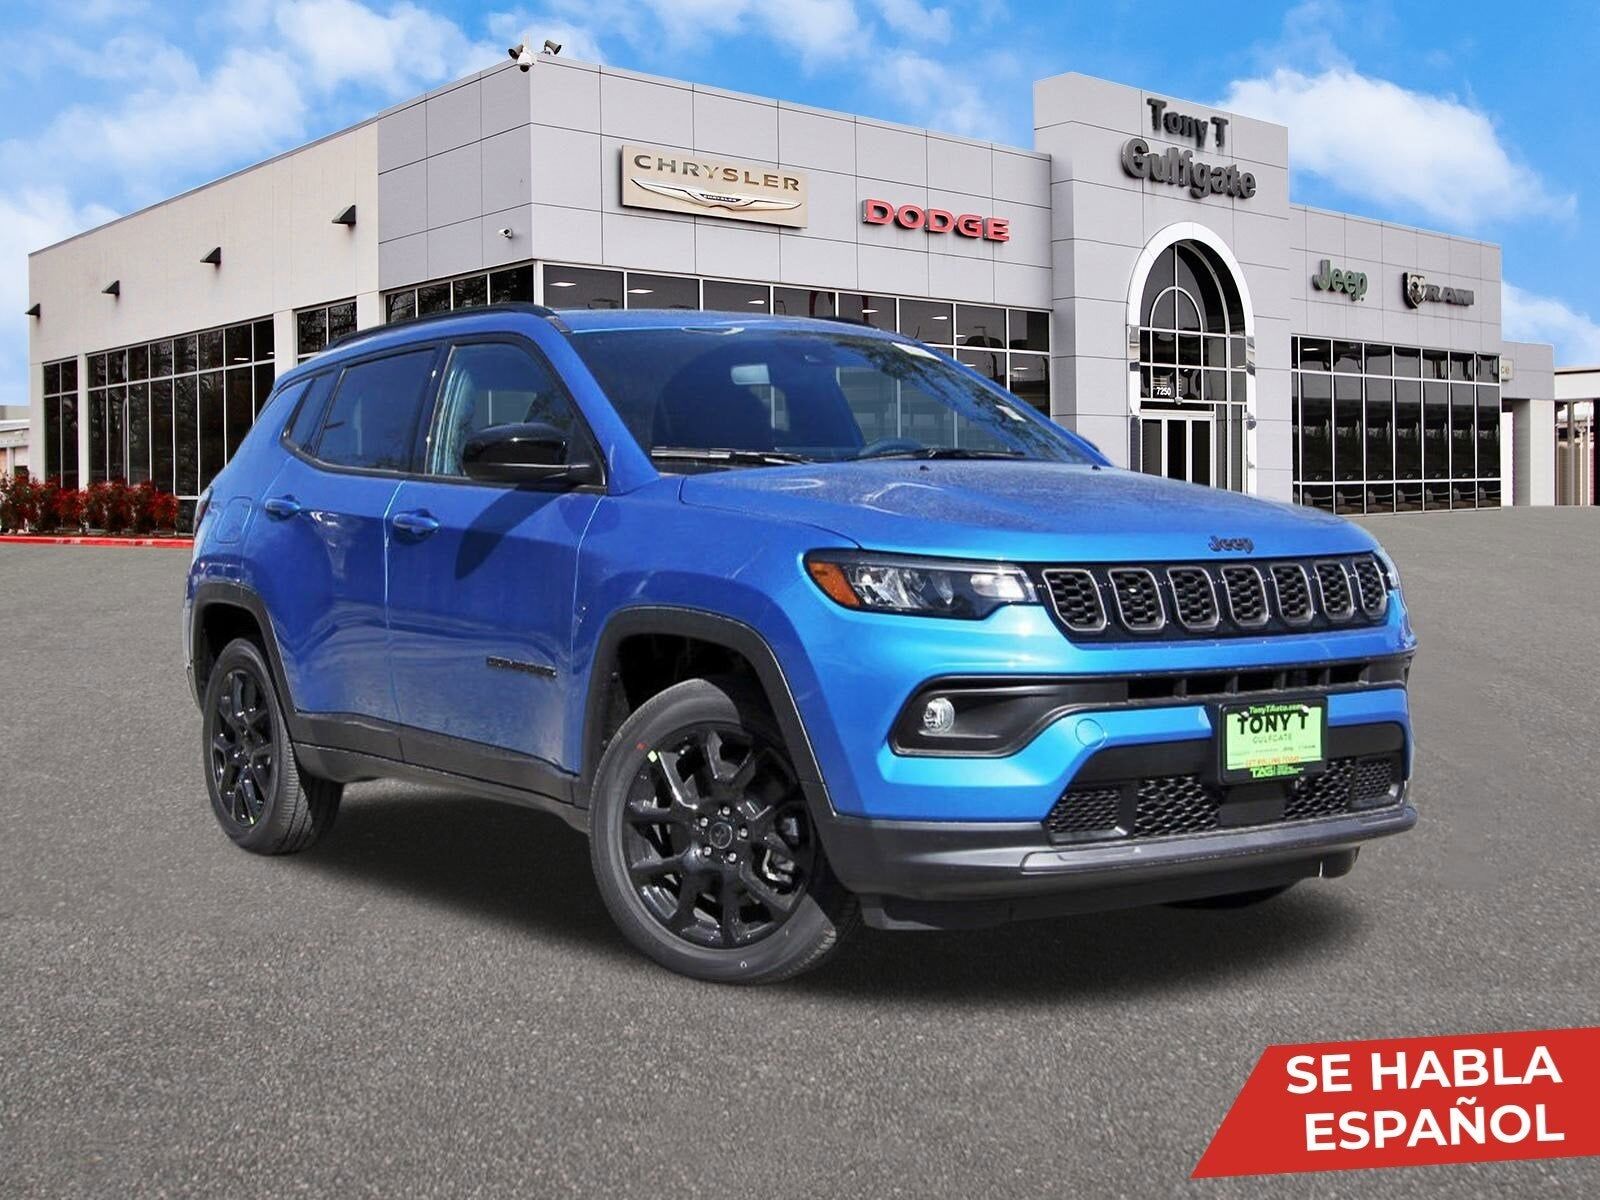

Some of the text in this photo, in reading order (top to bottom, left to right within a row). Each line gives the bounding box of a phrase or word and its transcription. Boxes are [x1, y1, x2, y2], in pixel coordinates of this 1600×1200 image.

[1147, 98, 1229, 147] Tony T
[633, 154, 800, 192] CHRYSLER
[1121, 138, 1257, 199] Gulfgate
[863, 198, 1010, 242] DODGE
[1312, 259, 1368, 302] Jeep
[1425, 284, 1475, 306] RAM
[1156, 386, 1171, 396] 7250
[1208, 536, 1254, 554] Jeep
[1237, 711, 1309, 735] TONY T
